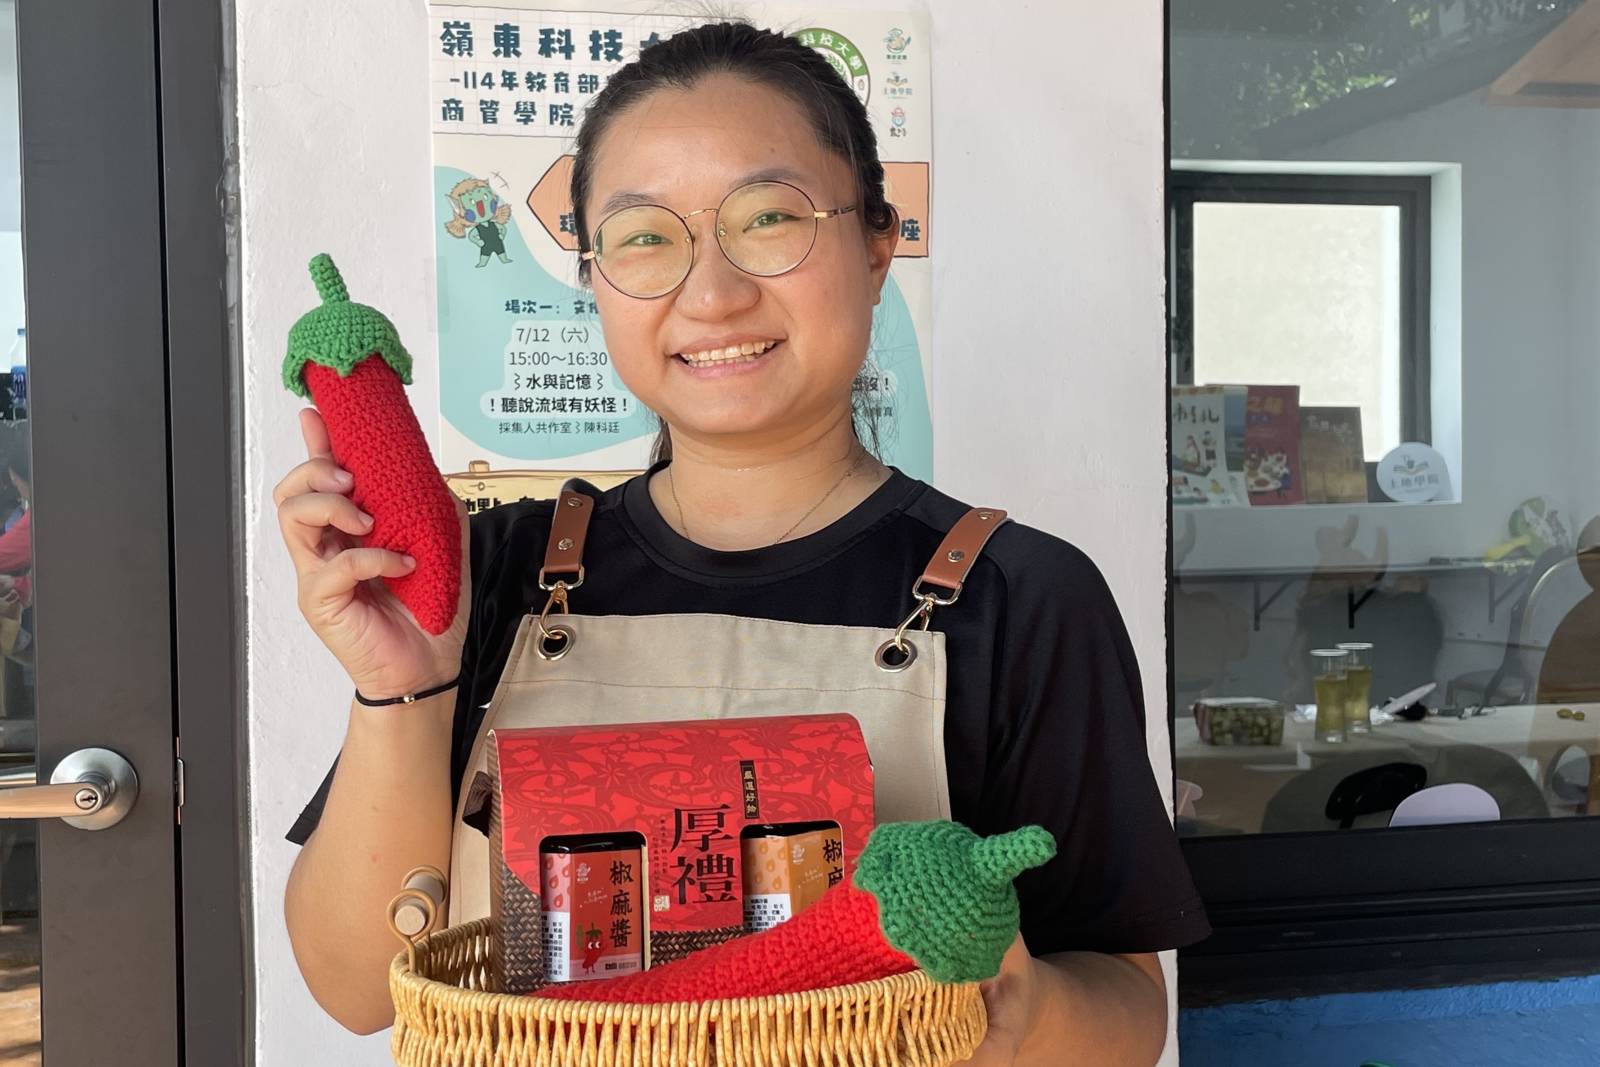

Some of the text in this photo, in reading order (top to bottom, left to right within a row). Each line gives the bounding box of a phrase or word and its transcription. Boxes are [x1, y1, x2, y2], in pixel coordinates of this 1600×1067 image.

[450, 70, 612, 94] -114年教育部
[442, 98, 575, 127] 商管學院
[900, 219, 921, 241] 座
[526, 374, 592, 390] 水與記憶
[669, 803, 738, 905] 厚禮
[609, 859, 635, 948] 椒麻醬
